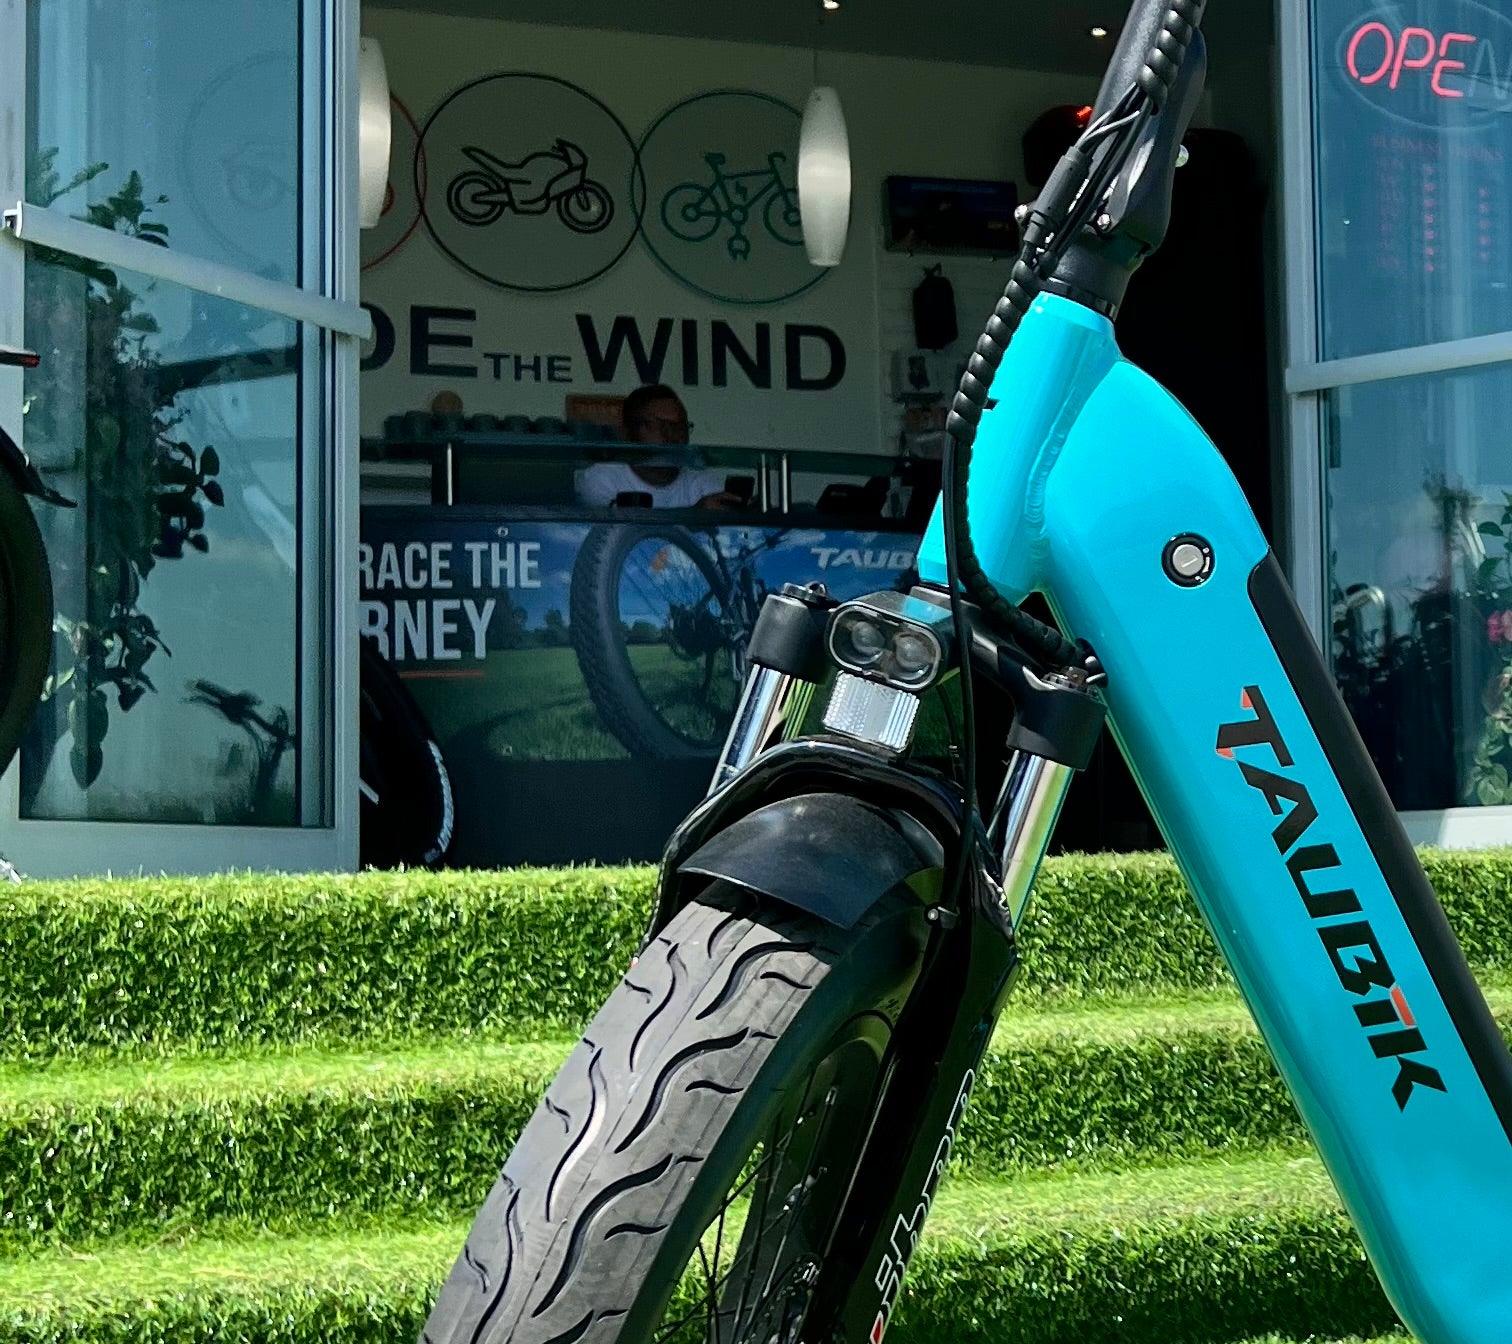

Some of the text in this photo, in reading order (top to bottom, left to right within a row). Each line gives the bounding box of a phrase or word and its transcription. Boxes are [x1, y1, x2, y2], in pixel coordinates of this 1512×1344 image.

[483, 352, 574, 383] THE
[575, 313, 848, 392] WIND
[464, 541, 542, 589] THE
[810, 547, 918, 571] TAUB
[1215, 684, 1448, 1113] TAUBIK
